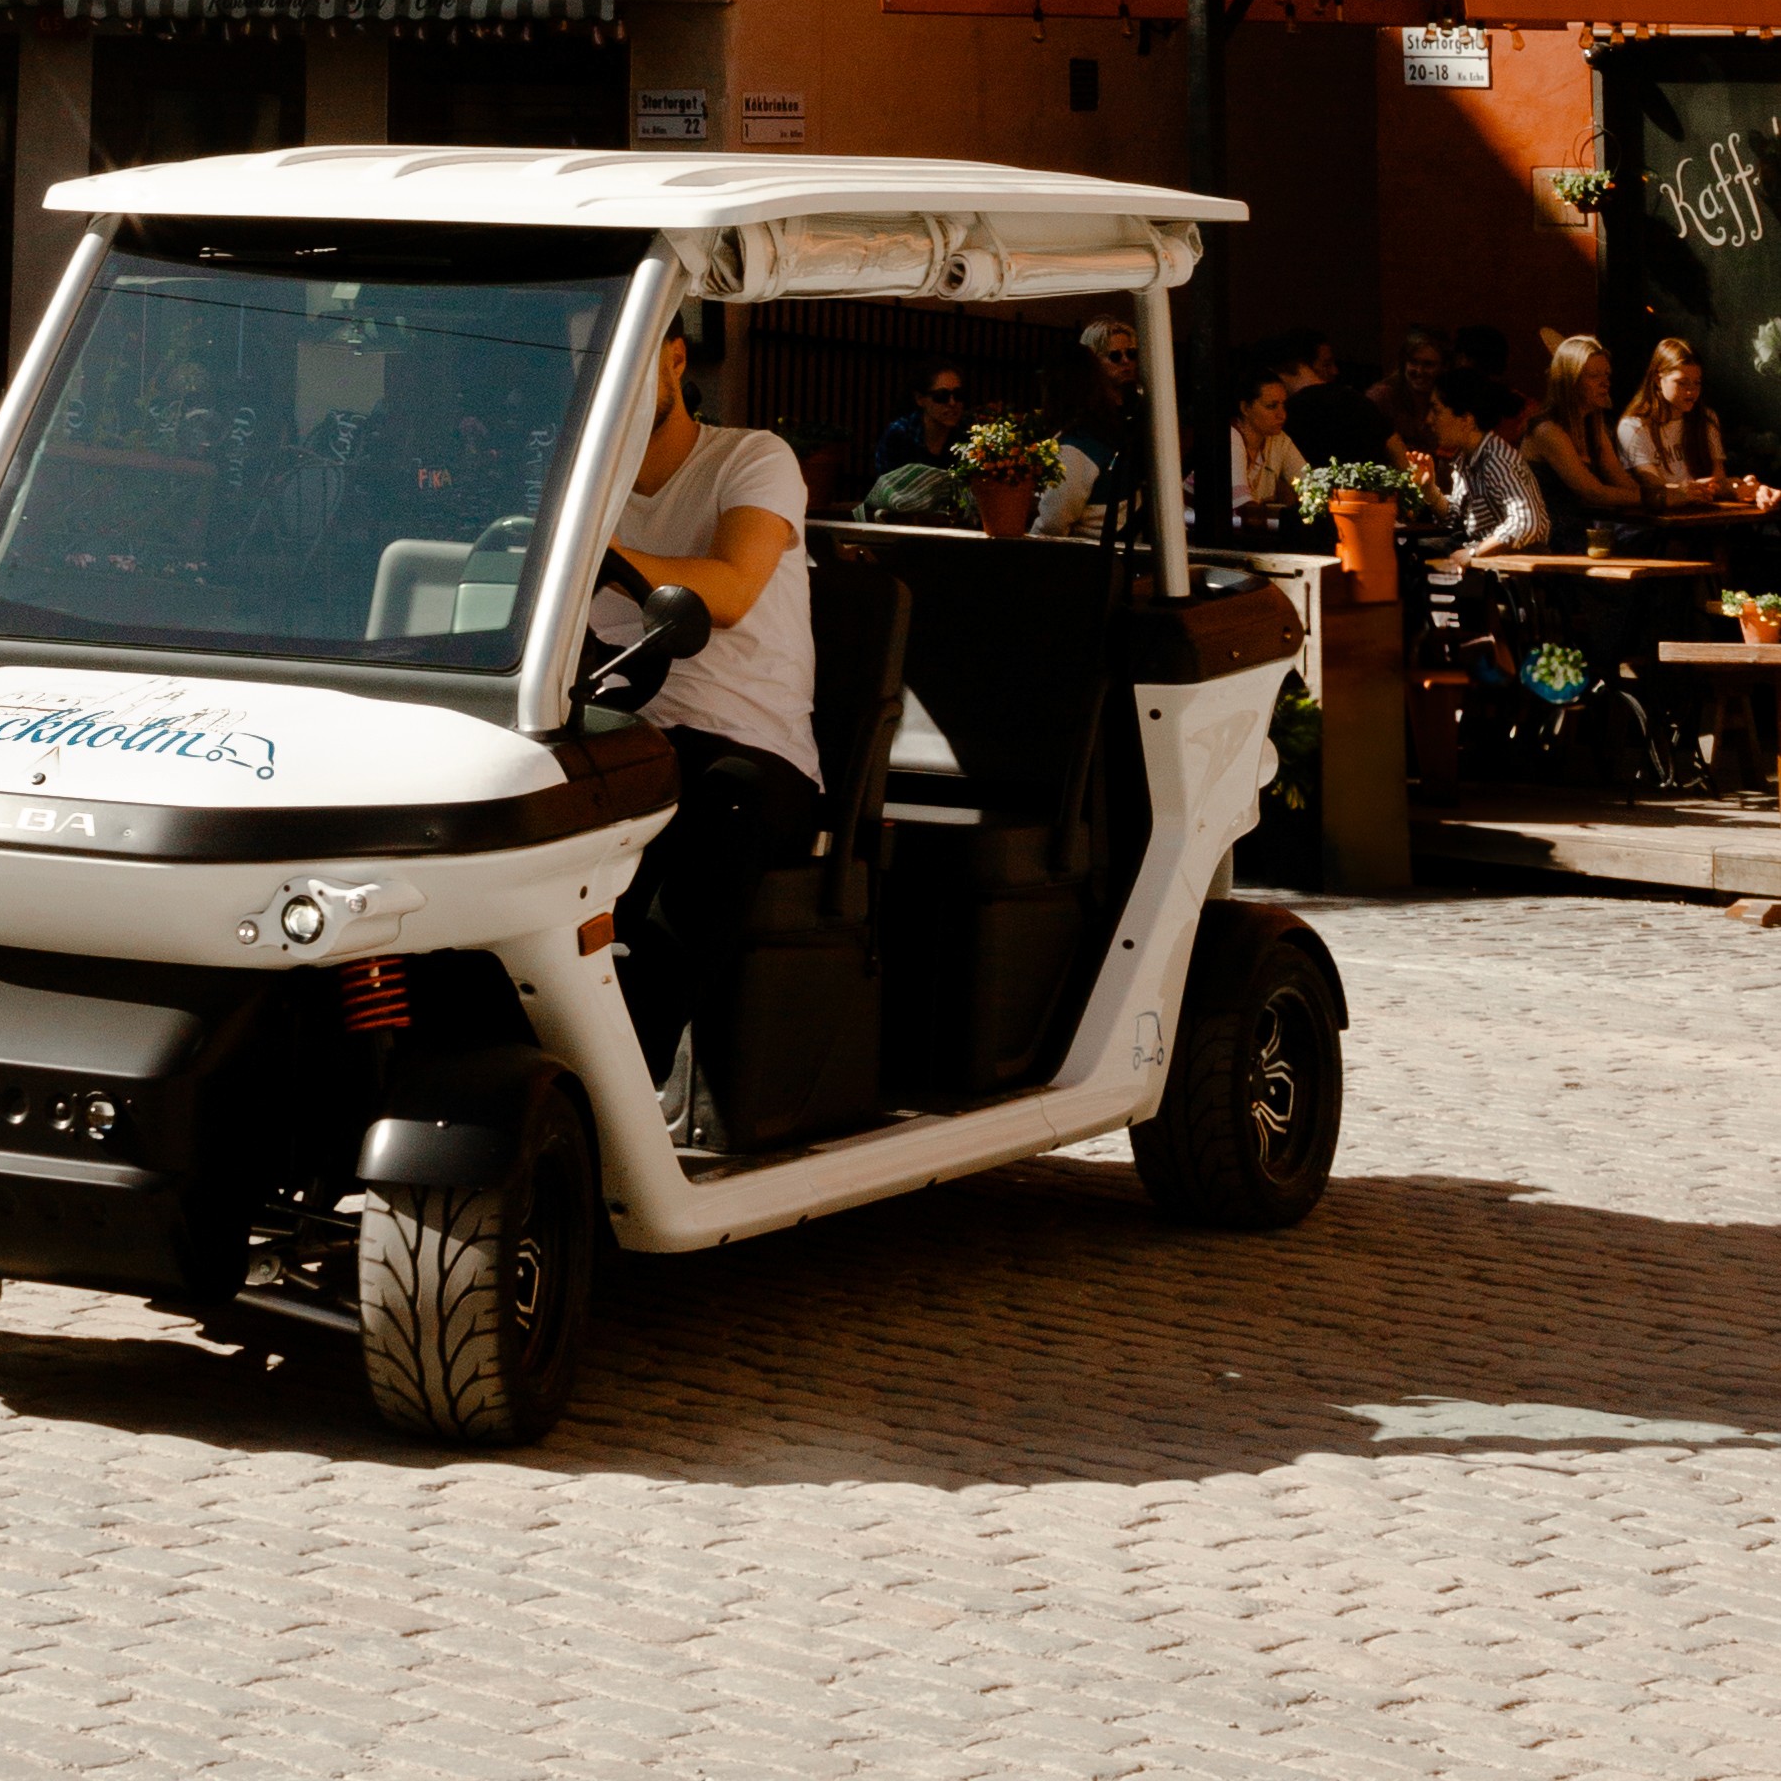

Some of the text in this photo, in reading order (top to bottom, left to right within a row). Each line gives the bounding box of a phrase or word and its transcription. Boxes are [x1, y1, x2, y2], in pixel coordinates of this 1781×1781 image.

[1408, 64, 1449, 81] 20-18
[641, 94, 698, 113] Stortorget
[744, 96, 799, 112] Kåkbrinken
[684, 118, 701, 135] 22
[1659, 132, 1763, 248] Kaff
